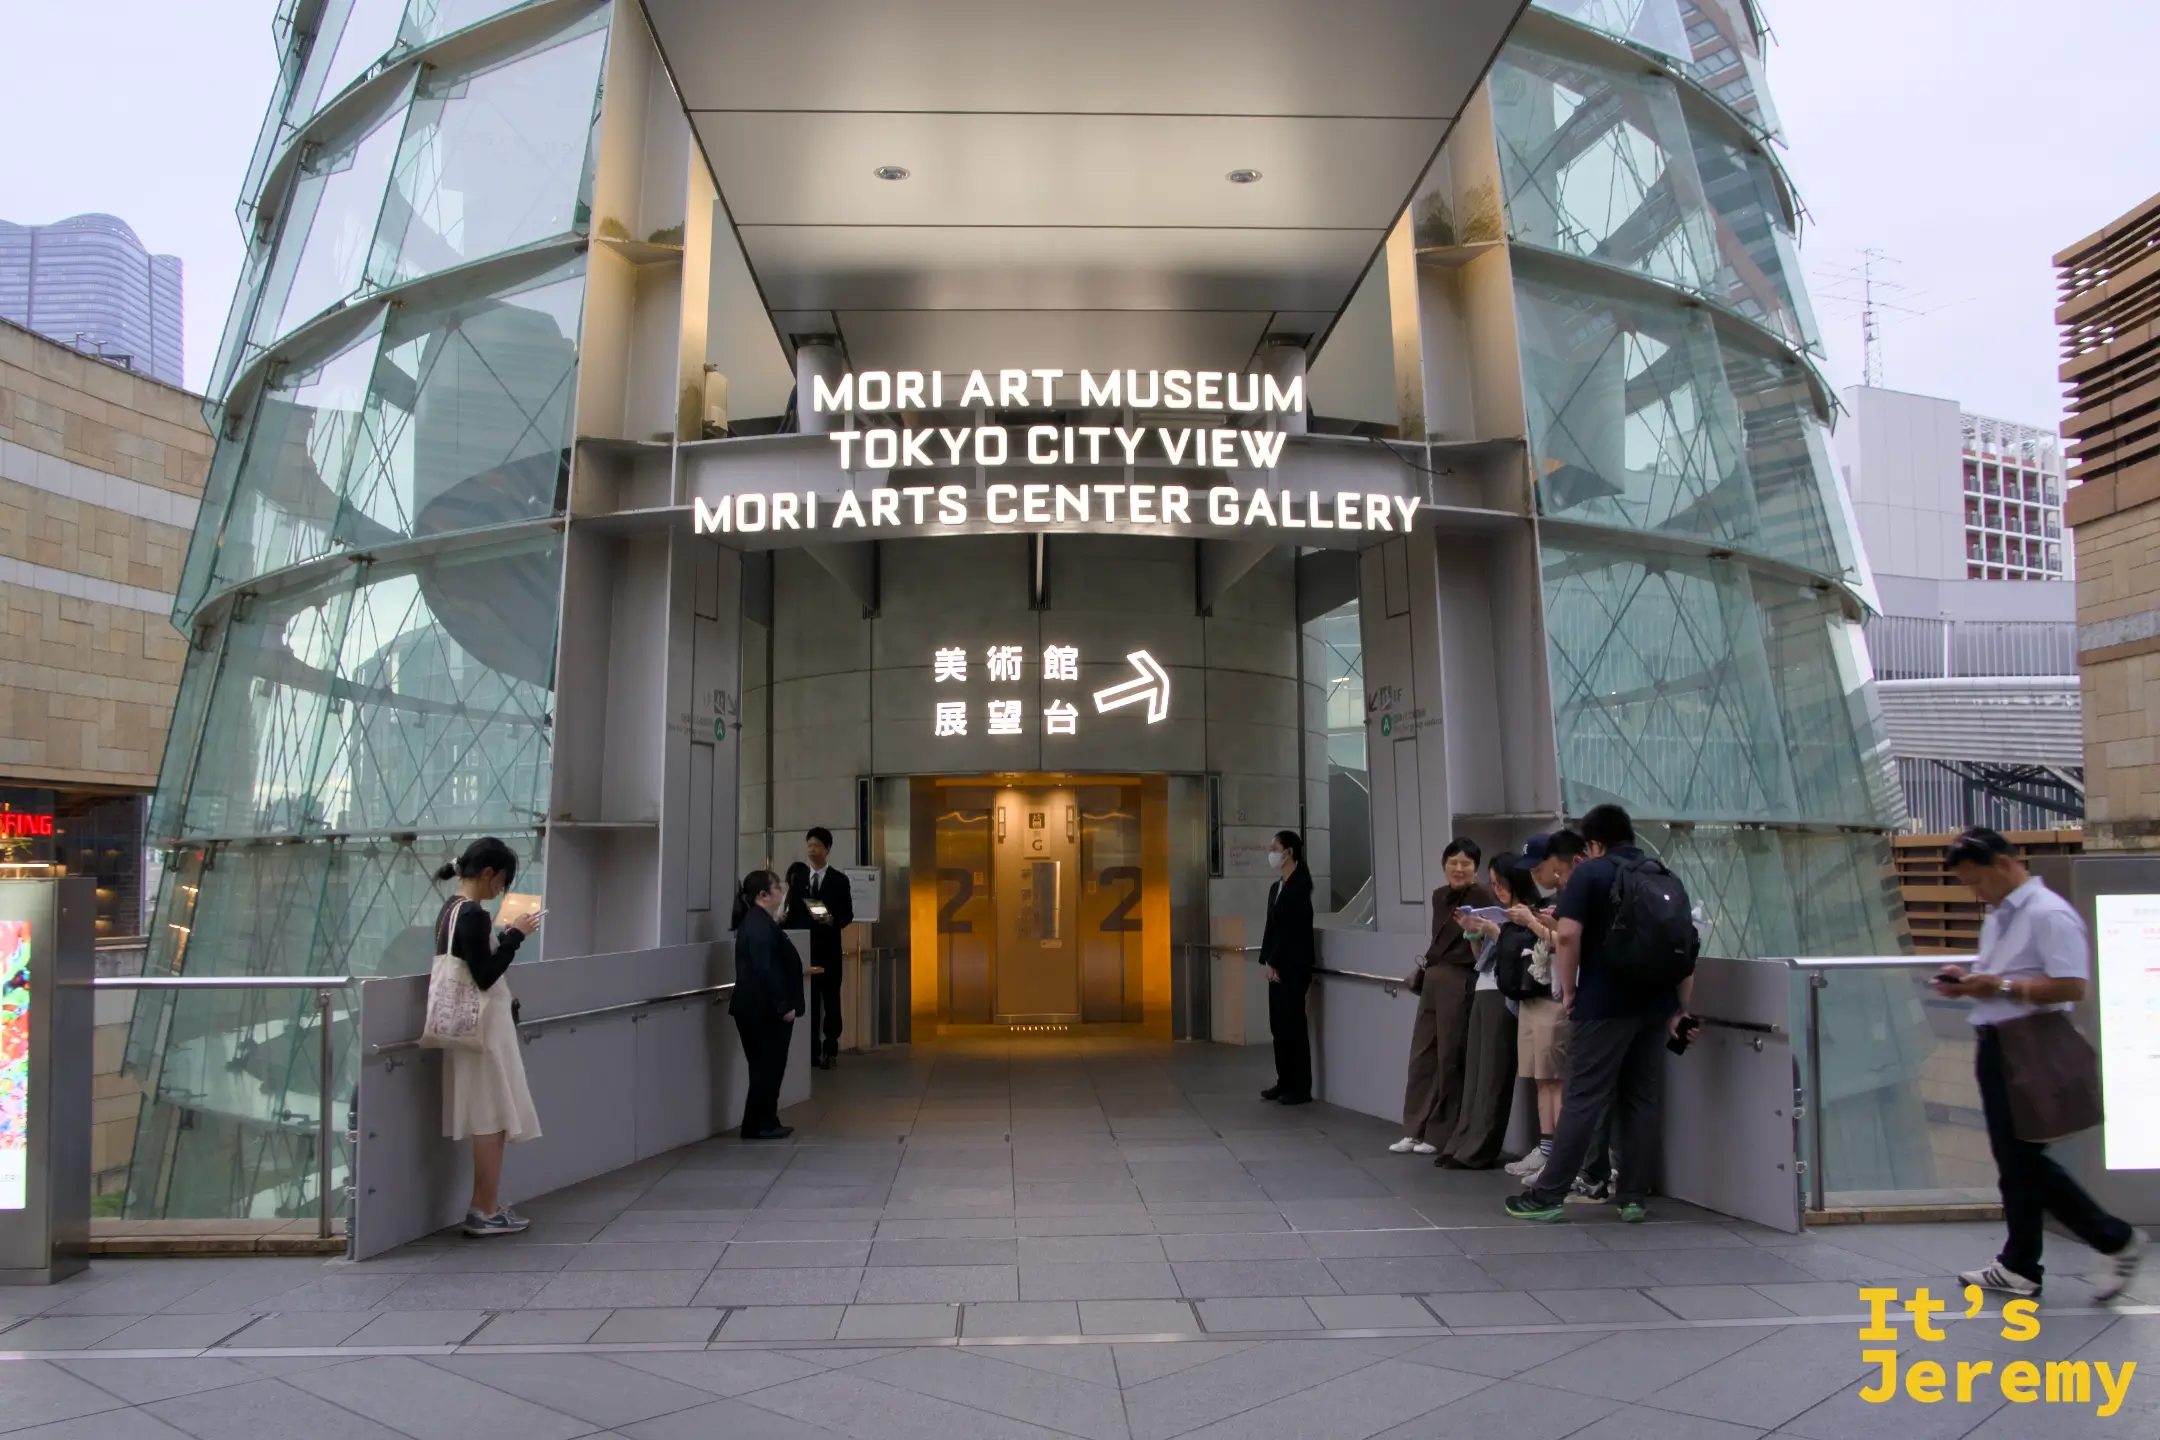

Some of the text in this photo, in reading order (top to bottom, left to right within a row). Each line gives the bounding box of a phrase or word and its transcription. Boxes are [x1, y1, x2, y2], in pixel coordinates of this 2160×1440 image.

[812, 368, 1305, 414] MORI ART MUSEUM
[828, 424, 1288, 470] TOKYO CITY VIEW
[693, 483, 1422, 535] MORI ARTS CENTER GALLERY
[933, 643, 1080, 684] 美術館
[933, 698, 1080, 738] 展望台
[1031, 839, 1043, 851] G
[937, 867, 974, 933] 2
[1100, 866, 1143, 932] 2
